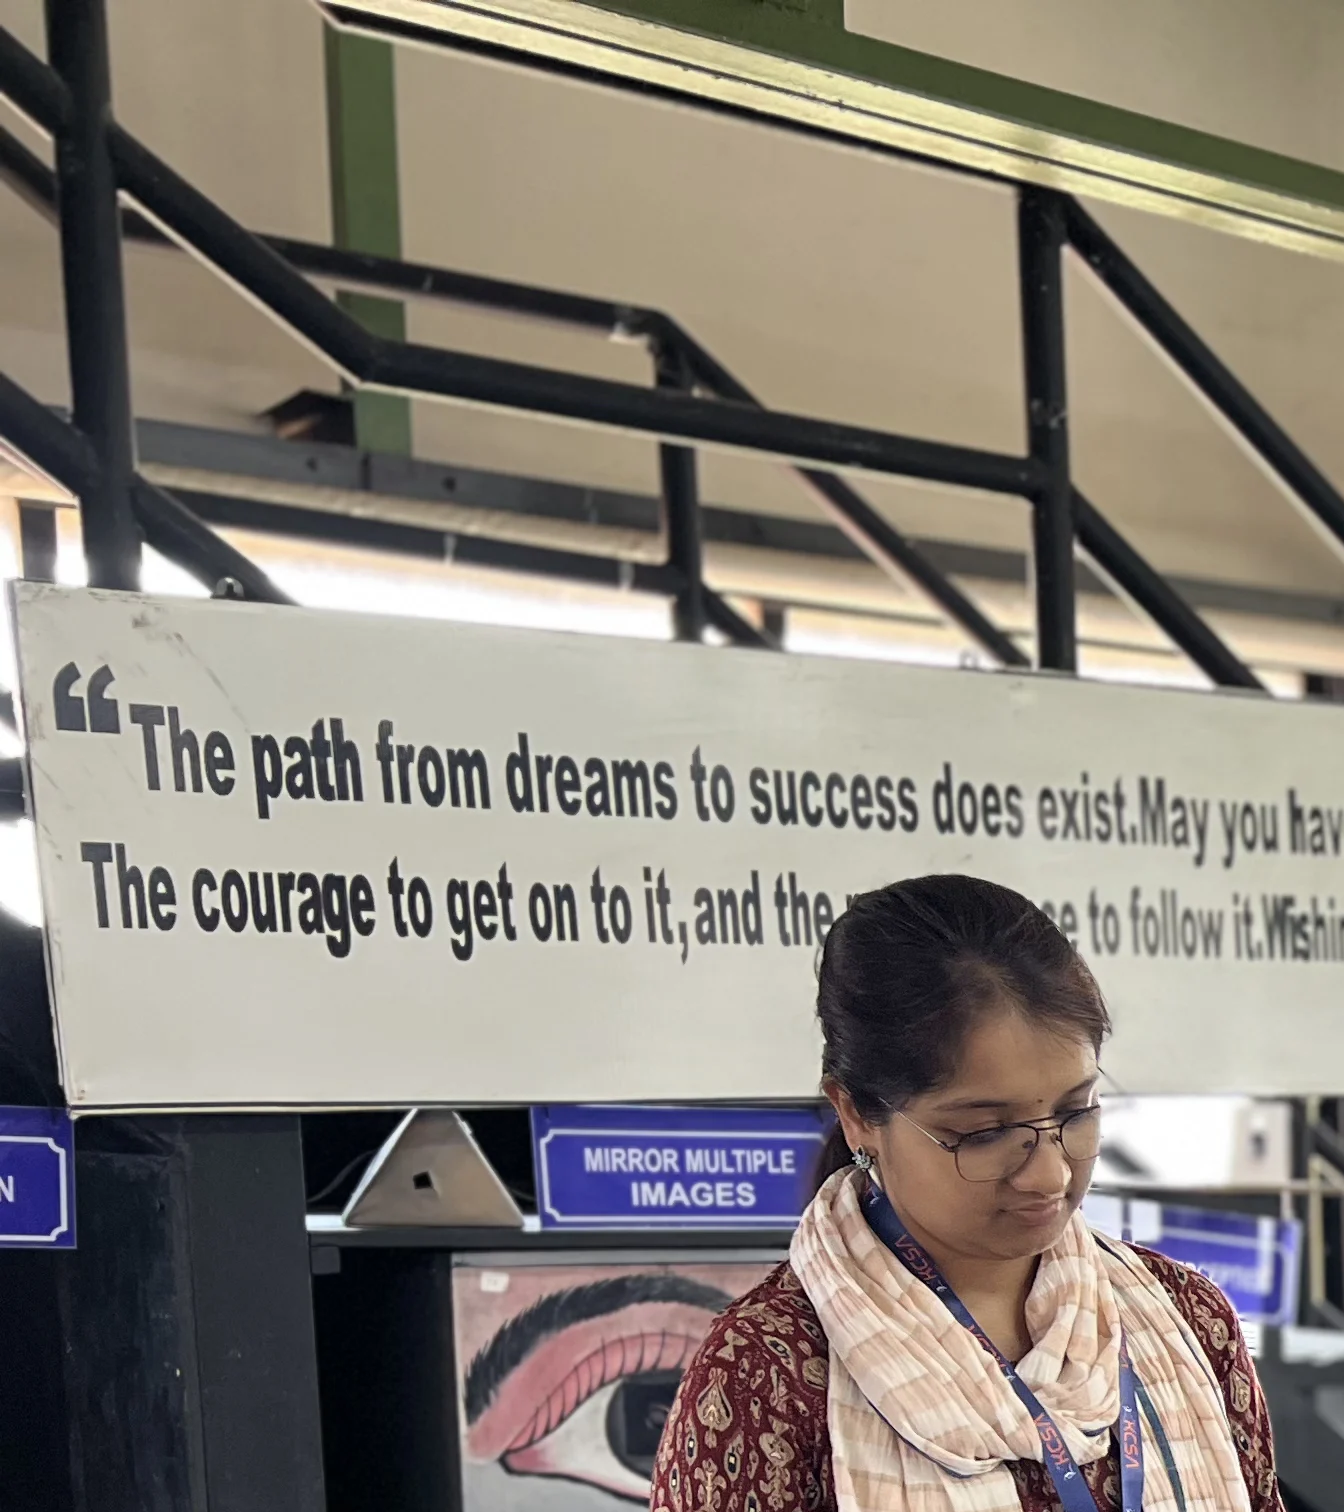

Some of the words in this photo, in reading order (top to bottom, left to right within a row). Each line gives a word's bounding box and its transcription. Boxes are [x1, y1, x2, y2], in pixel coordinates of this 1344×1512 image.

[253, 718, 364, 819] path
[377, 720, 491, 810] from
[507, 733, 678, 821] dreams
[692, 745, 735, 824] to
[750, 770, 918, 833] success
[933, 763, 1025, 838] does
[1220, 800, 1279, 867] you
[81, 842, 176, 931] The
[192, 865, 375, 958] courage
[388, 856, 432, 938] to
[448, 861, 518, 962] get
[528, 880, 579, 943] on
[591, 865, 634, 945] to
[774, 871, 833, 947] the
[1088, 887, 1119, 955] to
[1130, 888, 1223, 959] follow
[583, 1147, 680, 1174] MIRROR
[685, 1147, 796, 1176] MULTIPLE
[630, 1181, 757, 1208] IMAGES
